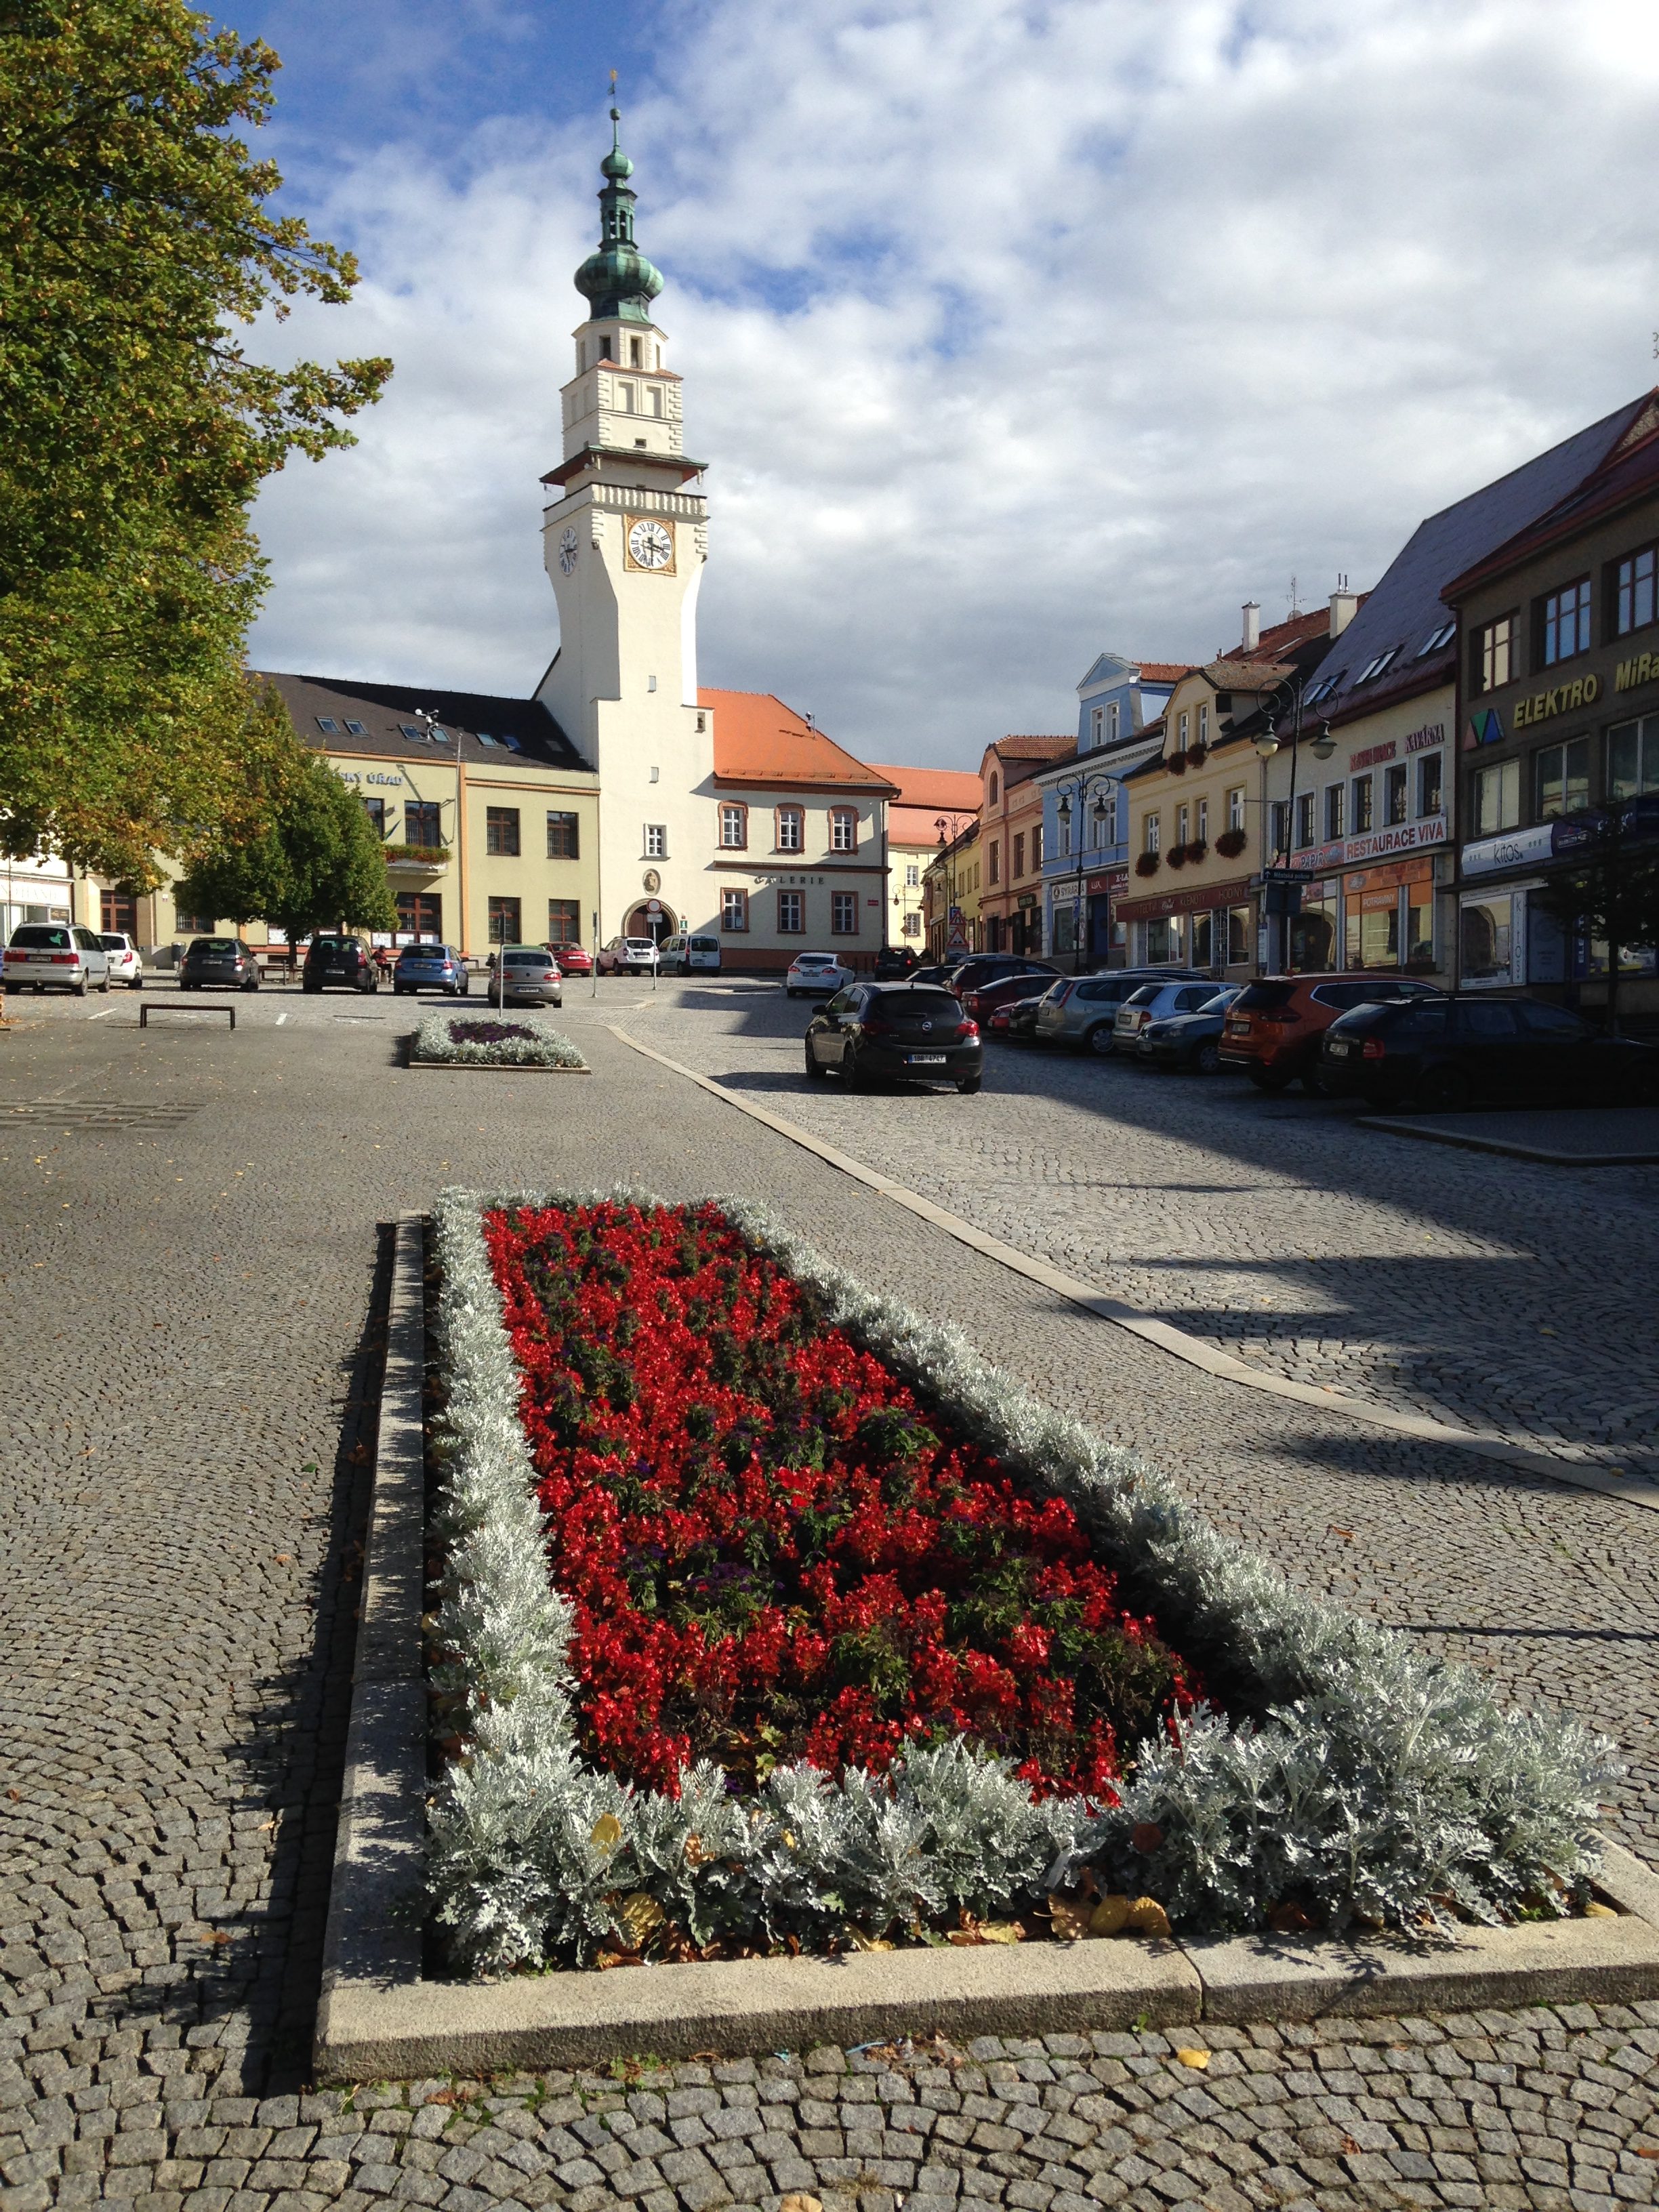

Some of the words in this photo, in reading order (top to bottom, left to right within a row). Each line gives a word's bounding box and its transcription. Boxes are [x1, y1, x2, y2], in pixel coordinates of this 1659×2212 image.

[1513, 674, 1598, 729] ELEKTRO
[1347, 827, 1415, 859] RESTAURACE
[1418, 821, 1444, 842] VIVA
[754, 876, 825, 885] GALERIE
[1061, 882, 1084, 897] SÝRÁRA
